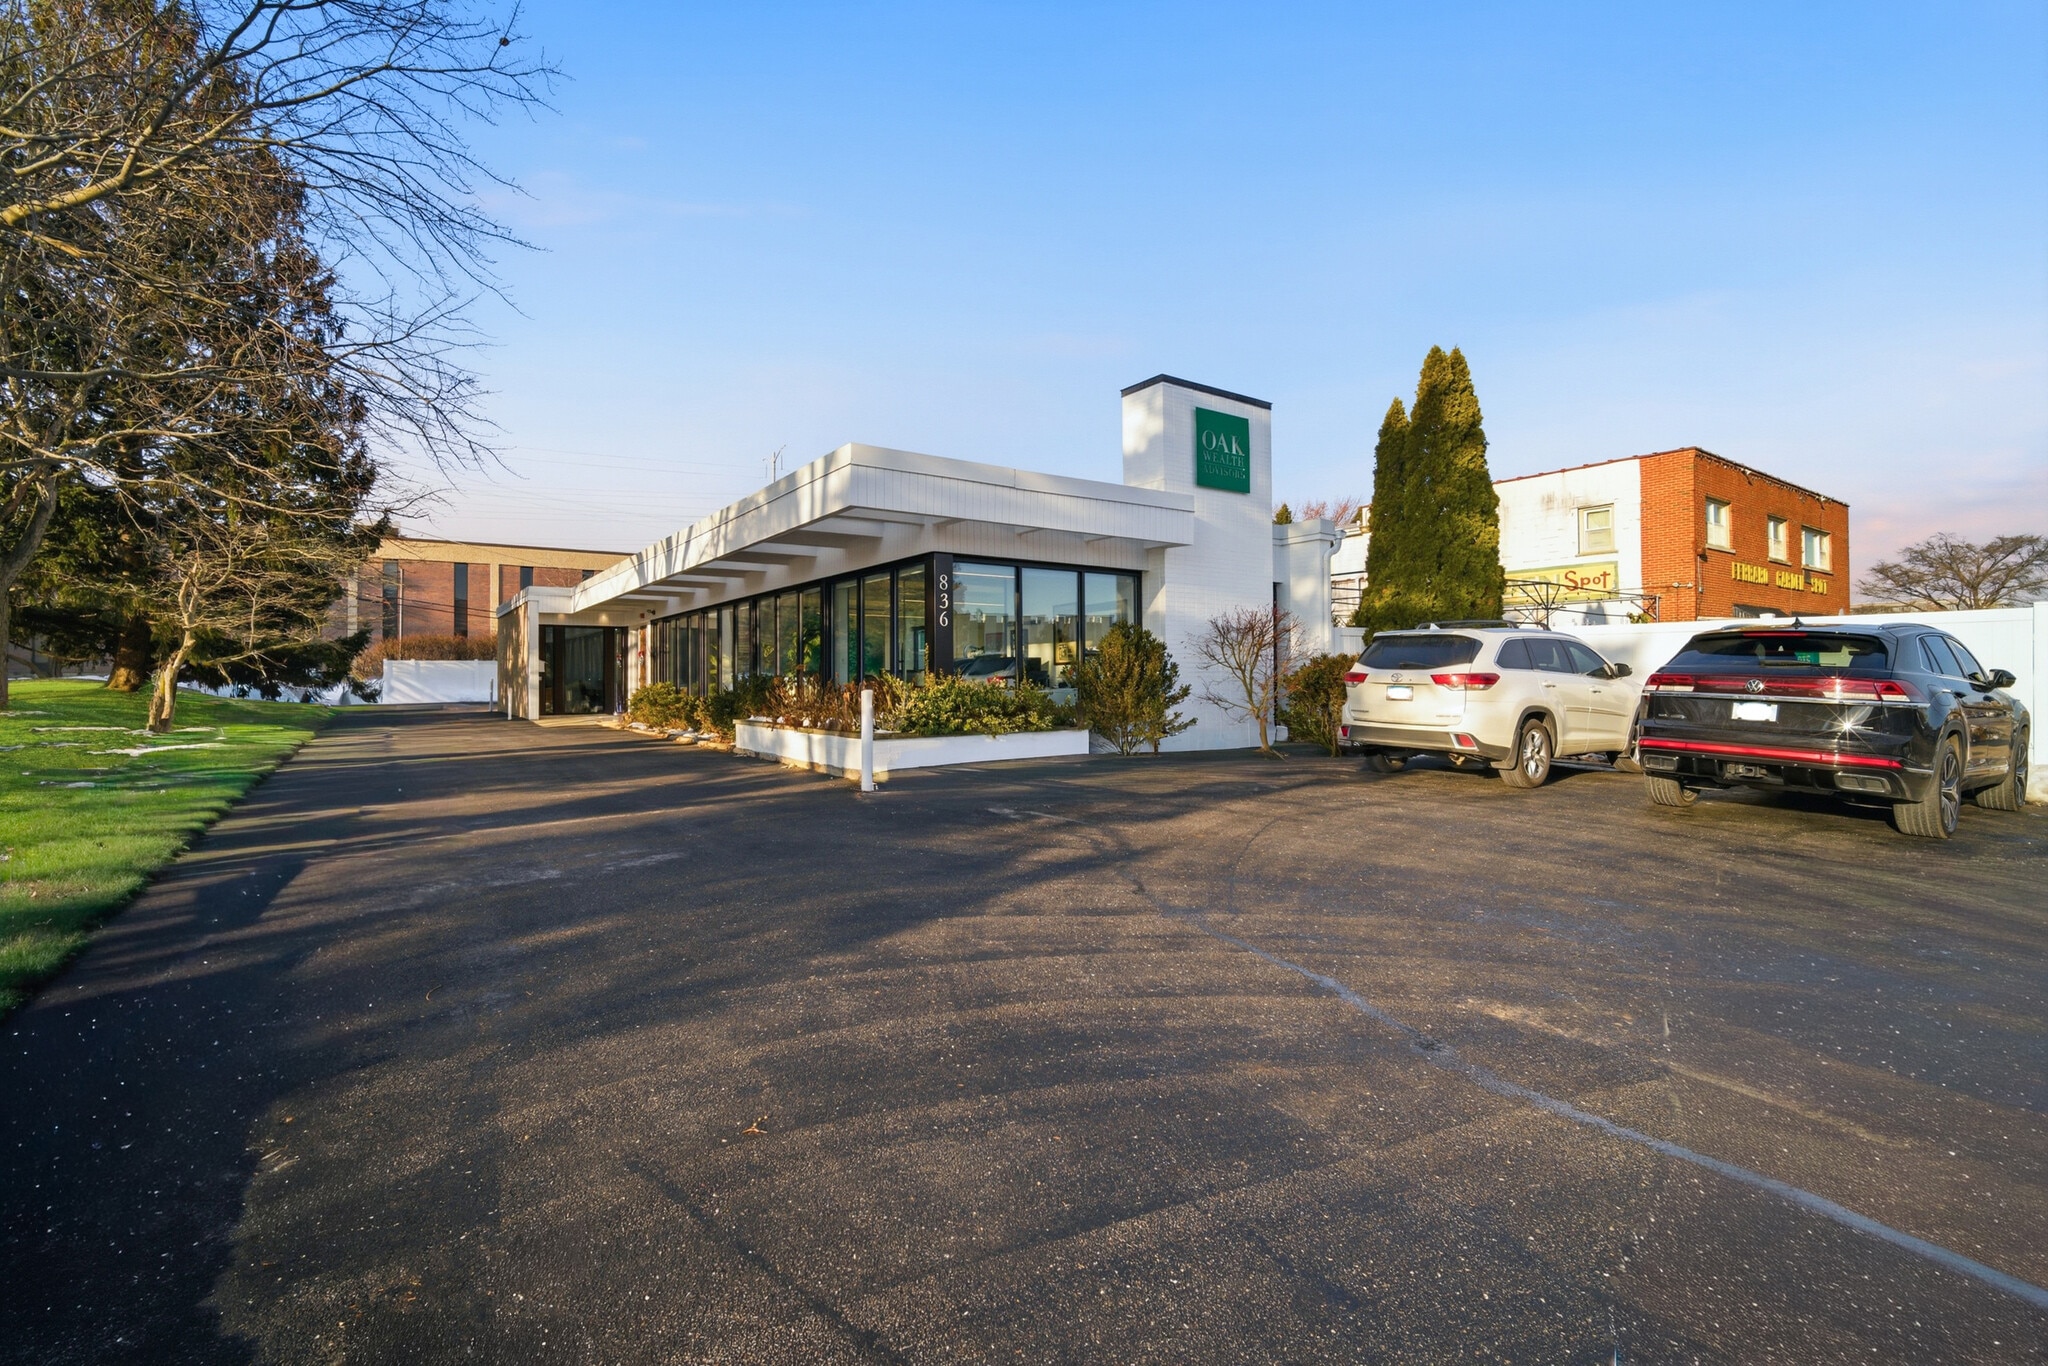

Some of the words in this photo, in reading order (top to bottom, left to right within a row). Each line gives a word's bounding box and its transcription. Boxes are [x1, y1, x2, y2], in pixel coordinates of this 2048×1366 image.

[1201, 429, 1245, 456] OAK
[1203, 450, 1245, 467] WEALTH
[1564, 570, 1611, 591] Spot
[1810, 577, 1827, 595] SPOT
[939, 574, 949, 627] 836
